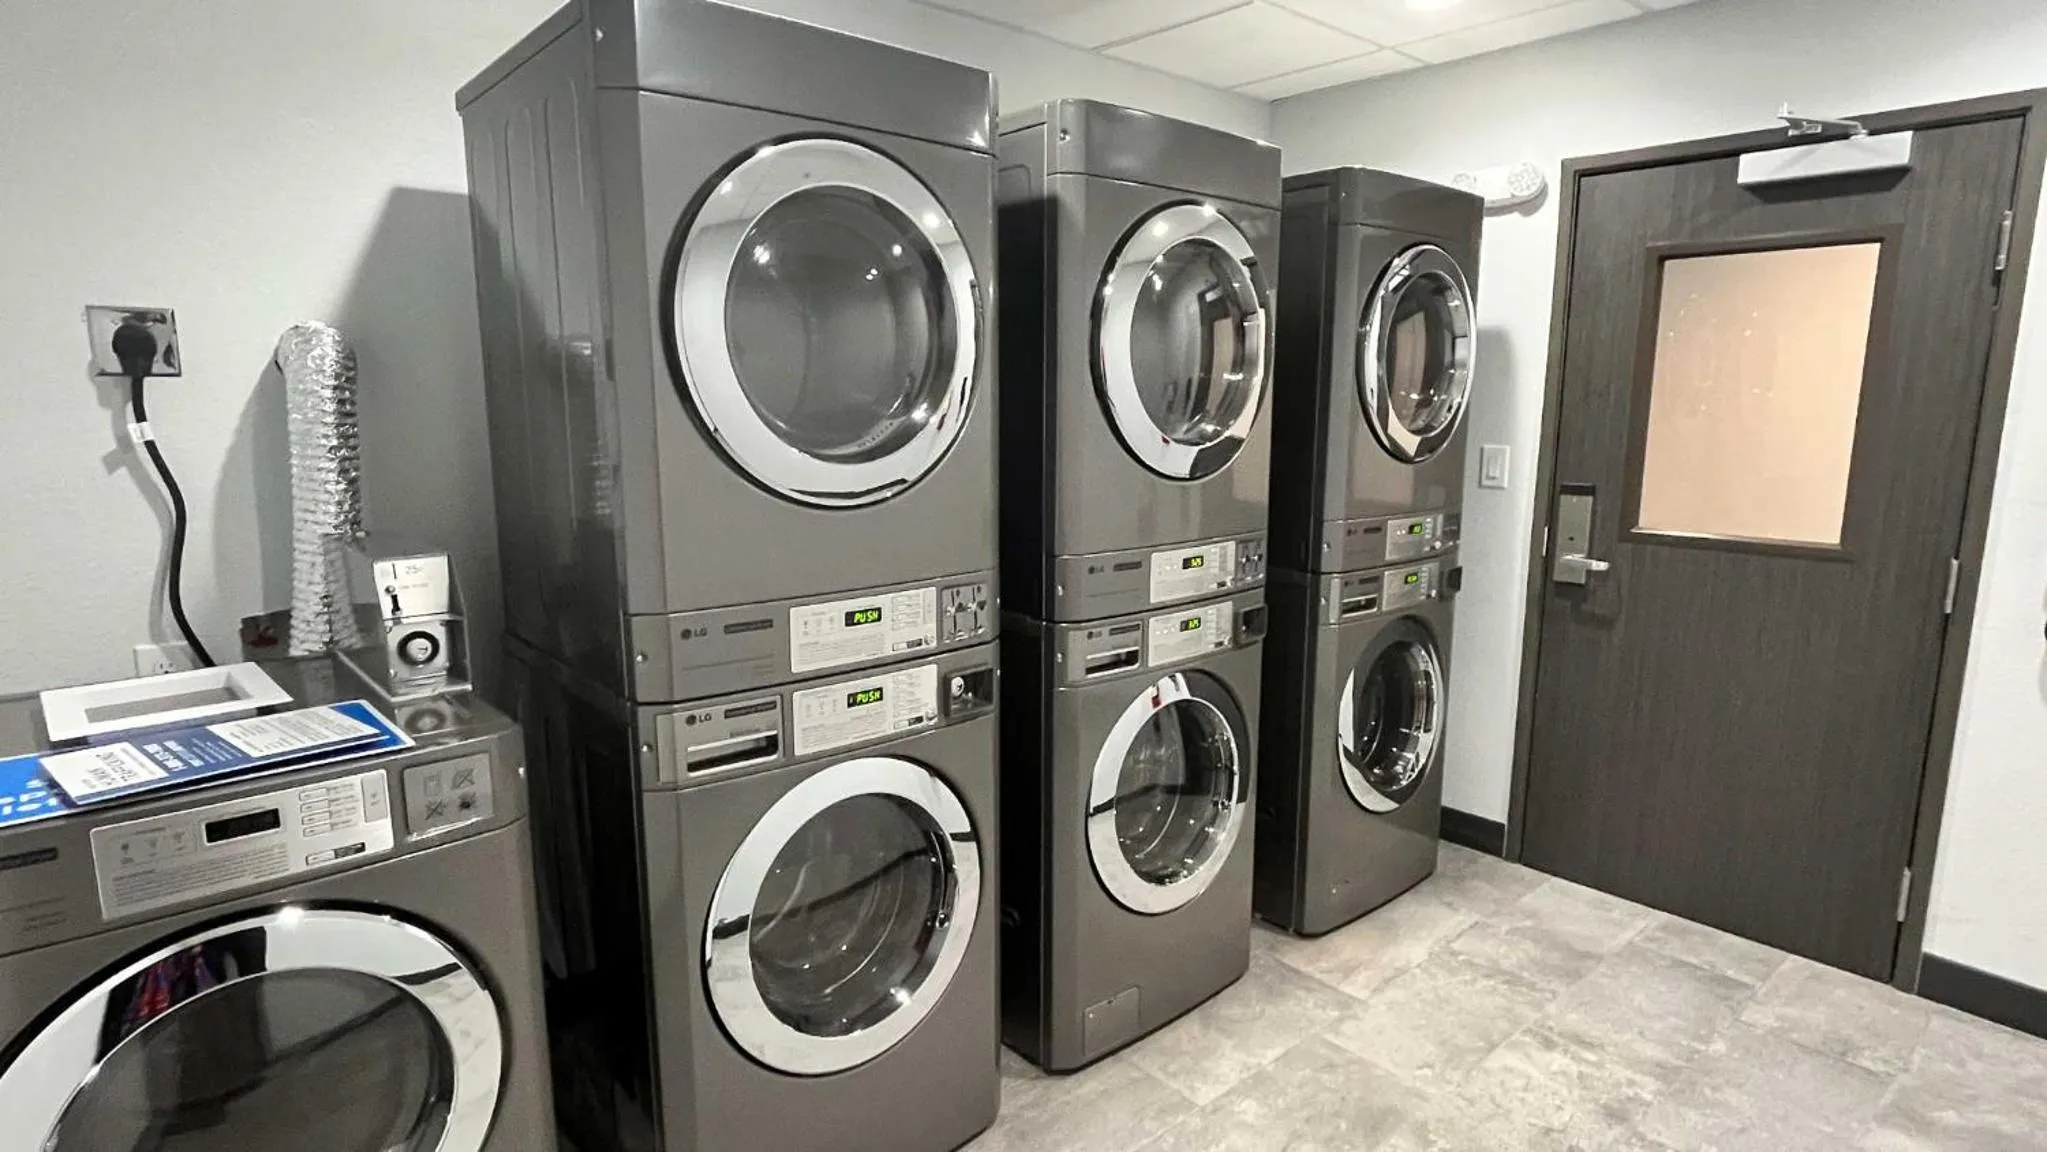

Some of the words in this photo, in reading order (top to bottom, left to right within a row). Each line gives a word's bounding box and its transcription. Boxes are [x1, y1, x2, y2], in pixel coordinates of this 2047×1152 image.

[854, 610, 878, 623] PUSH
[693, 627, 708, 638] LG
[856, 690, 880, 704] PUSH
[698, 712, 713, 724] LG
